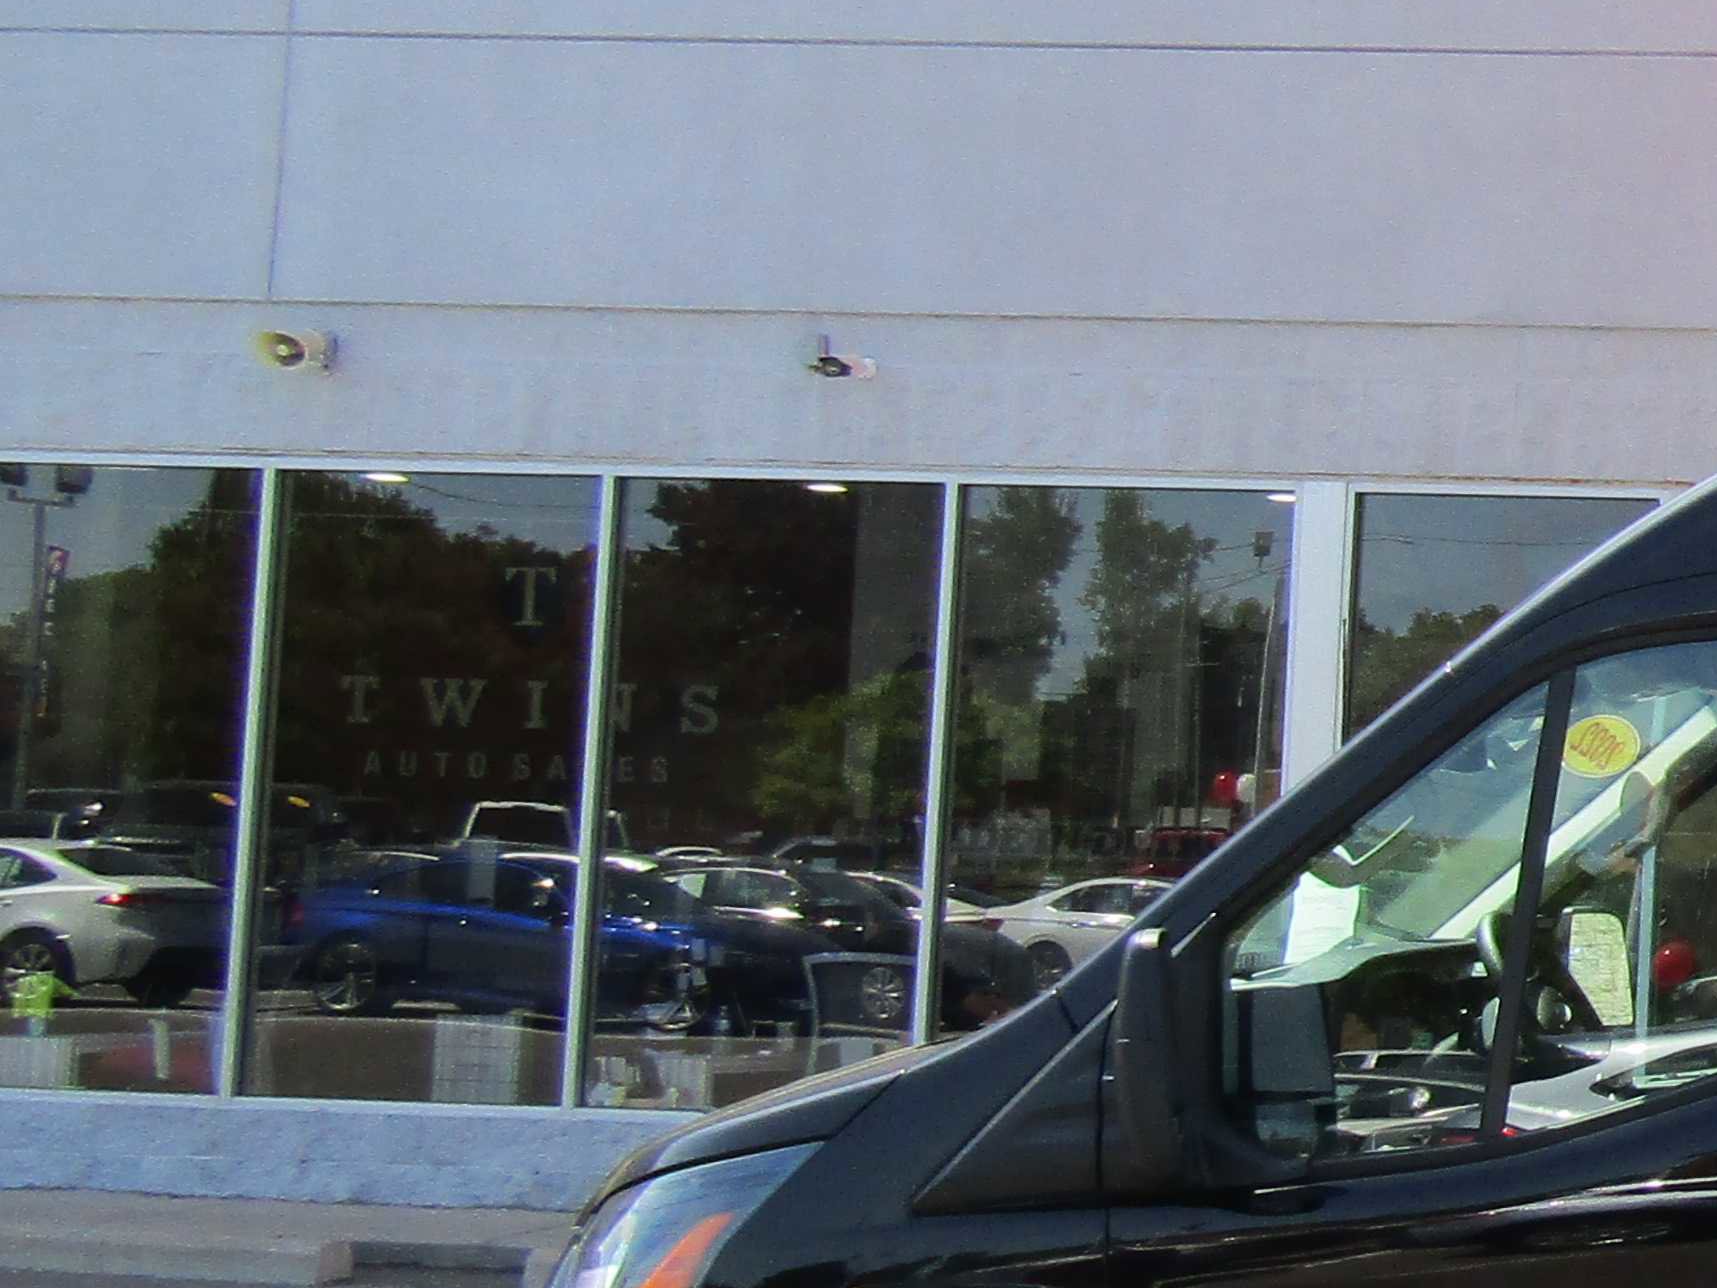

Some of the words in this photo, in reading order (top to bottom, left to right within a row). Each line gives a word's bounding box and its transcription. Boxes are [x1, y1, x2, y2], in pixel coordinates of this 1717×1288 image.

[503, 566, 558, 627] T
[364, 752, 489, 779] AUTO
[511, 752, 670, 784] SAES
